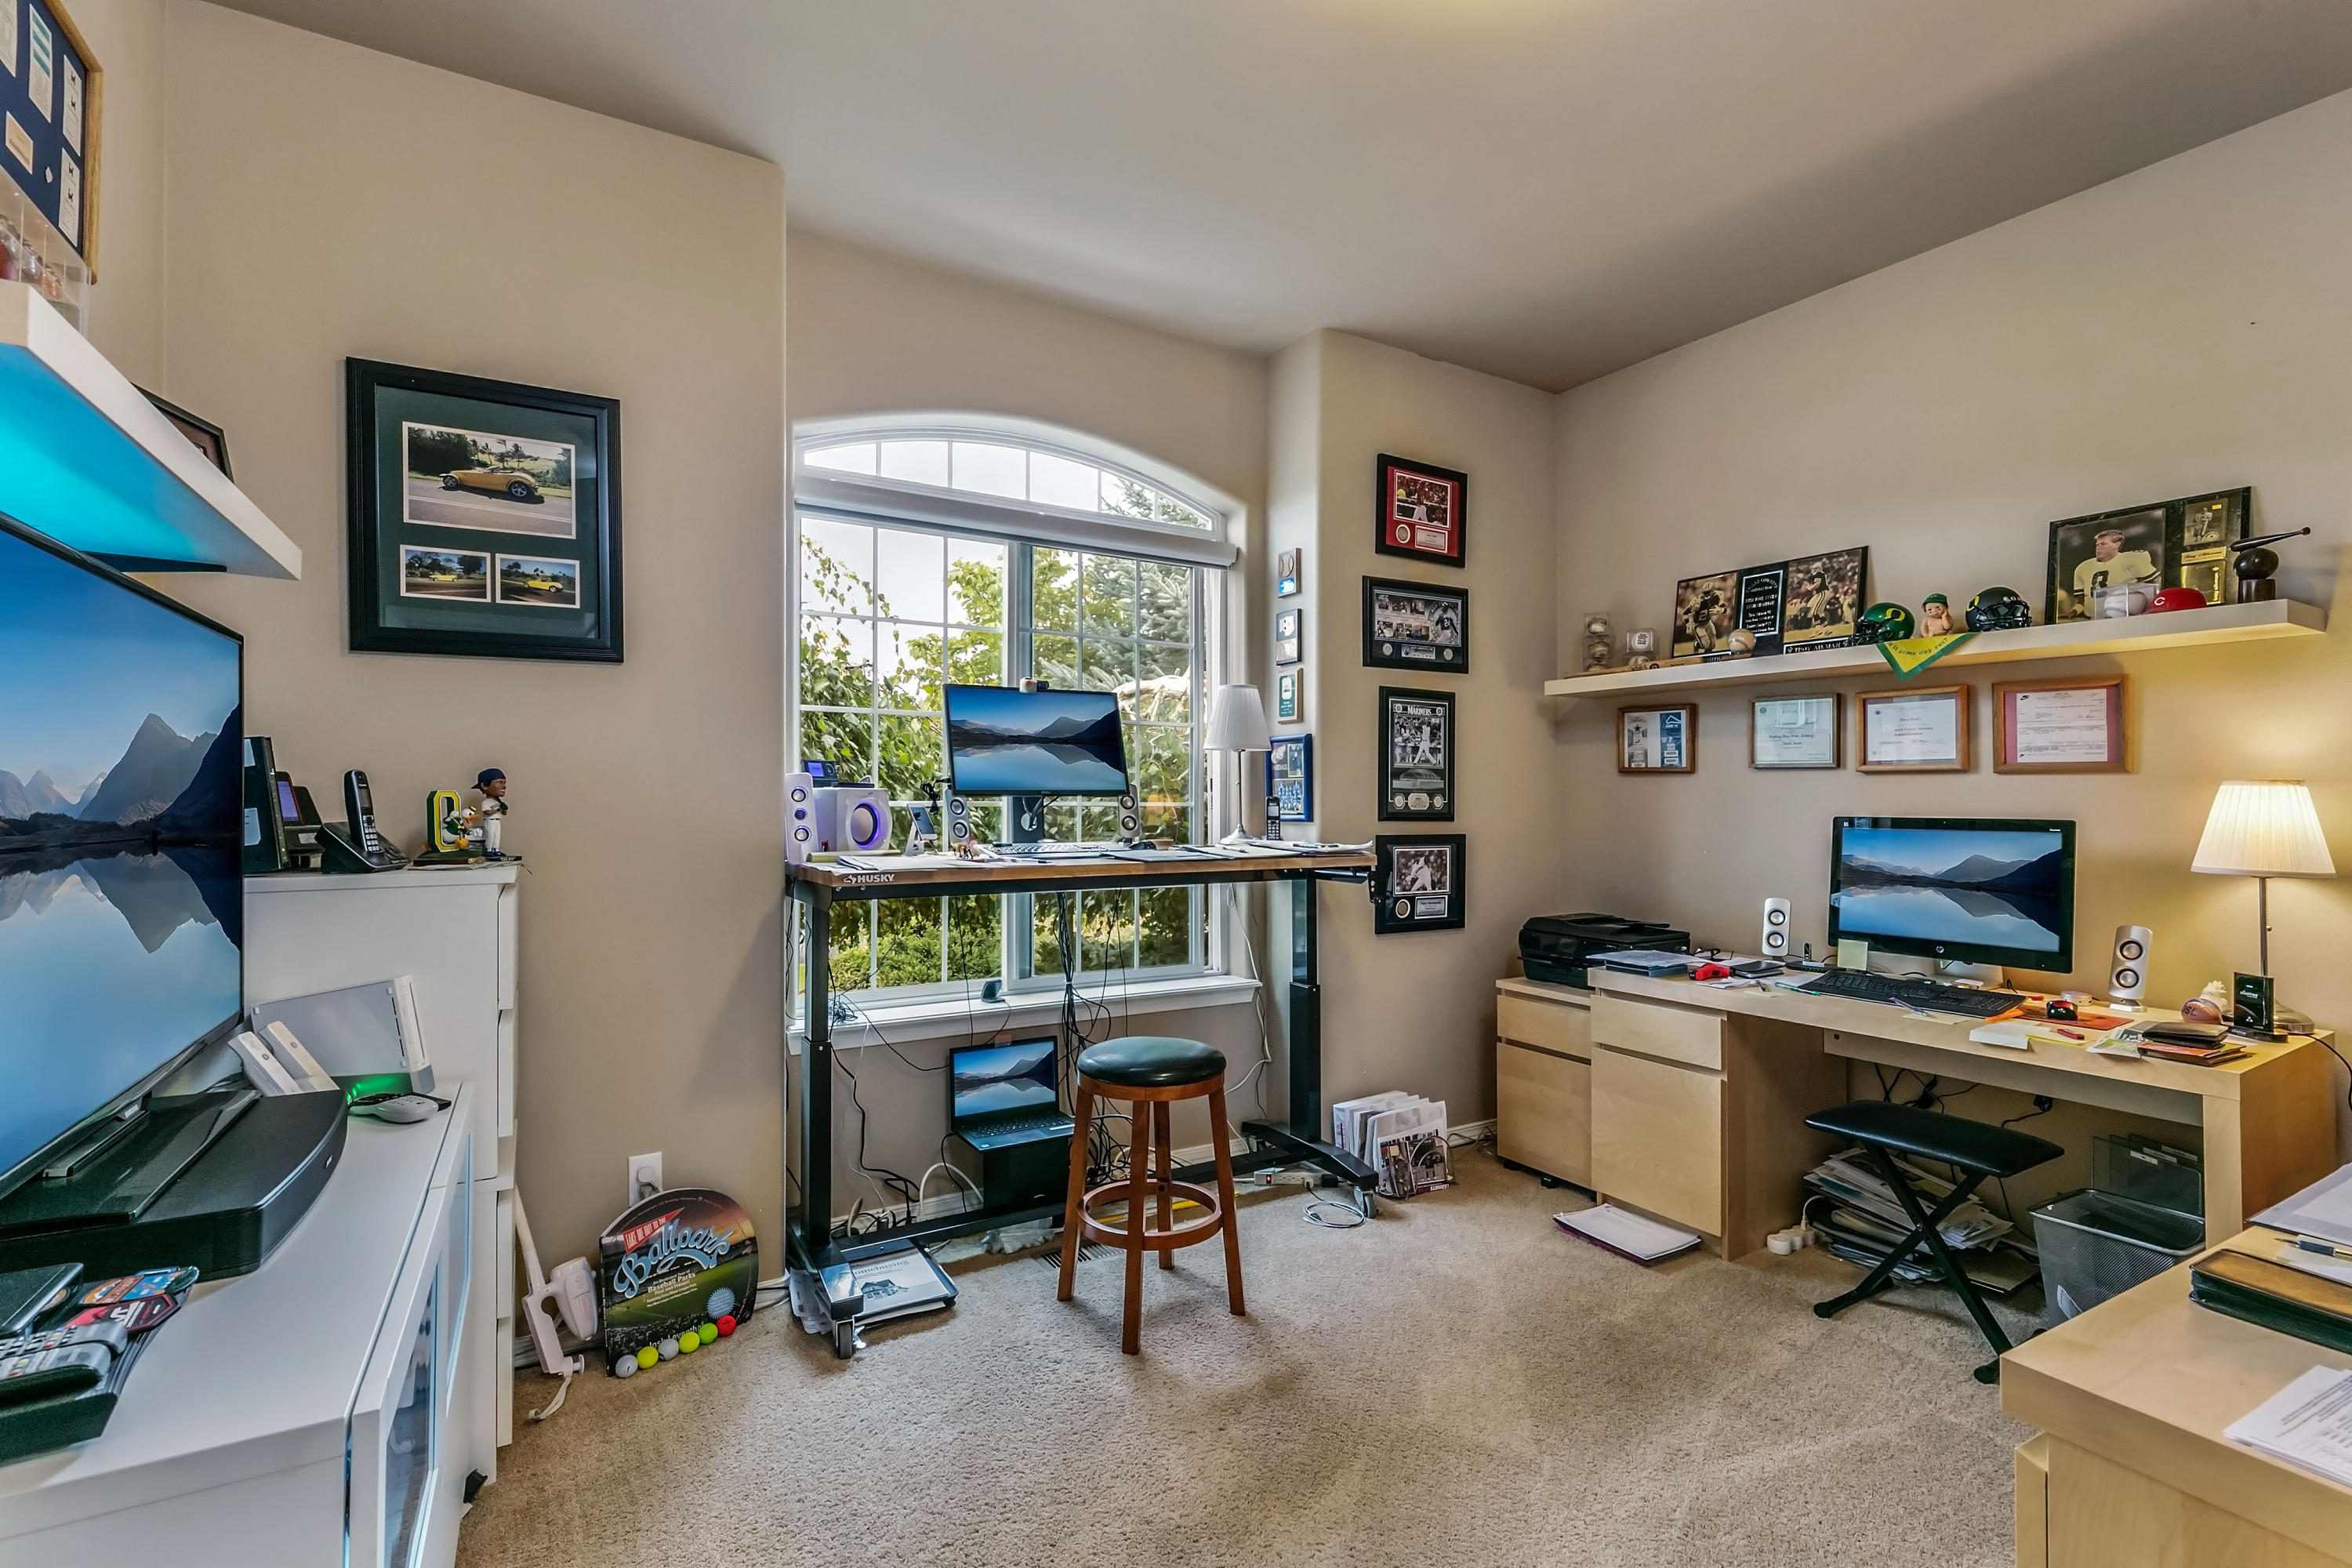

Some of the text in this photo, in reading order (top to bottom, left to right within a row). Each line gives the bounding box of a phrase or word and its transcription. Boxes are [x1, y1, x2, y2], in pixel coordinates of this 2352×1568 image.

[2154, 597, 2165, 606] C
[1407, 706, 1432, 715] MARINERS
[857, 873, 895, 884] HUSKY
[625, 1230, 639, 1250] TAKE
[636, 1226, 645, 1241] ME
[644, 1223, 654, 1237] OUT
[652, 1220, 659, 1230] TO
[614, 1218, 733, 1299] Ballpark
[855, 1260, 910, 1276] omebuying
[648, 1272, 696, 1293] Baseball Parks
